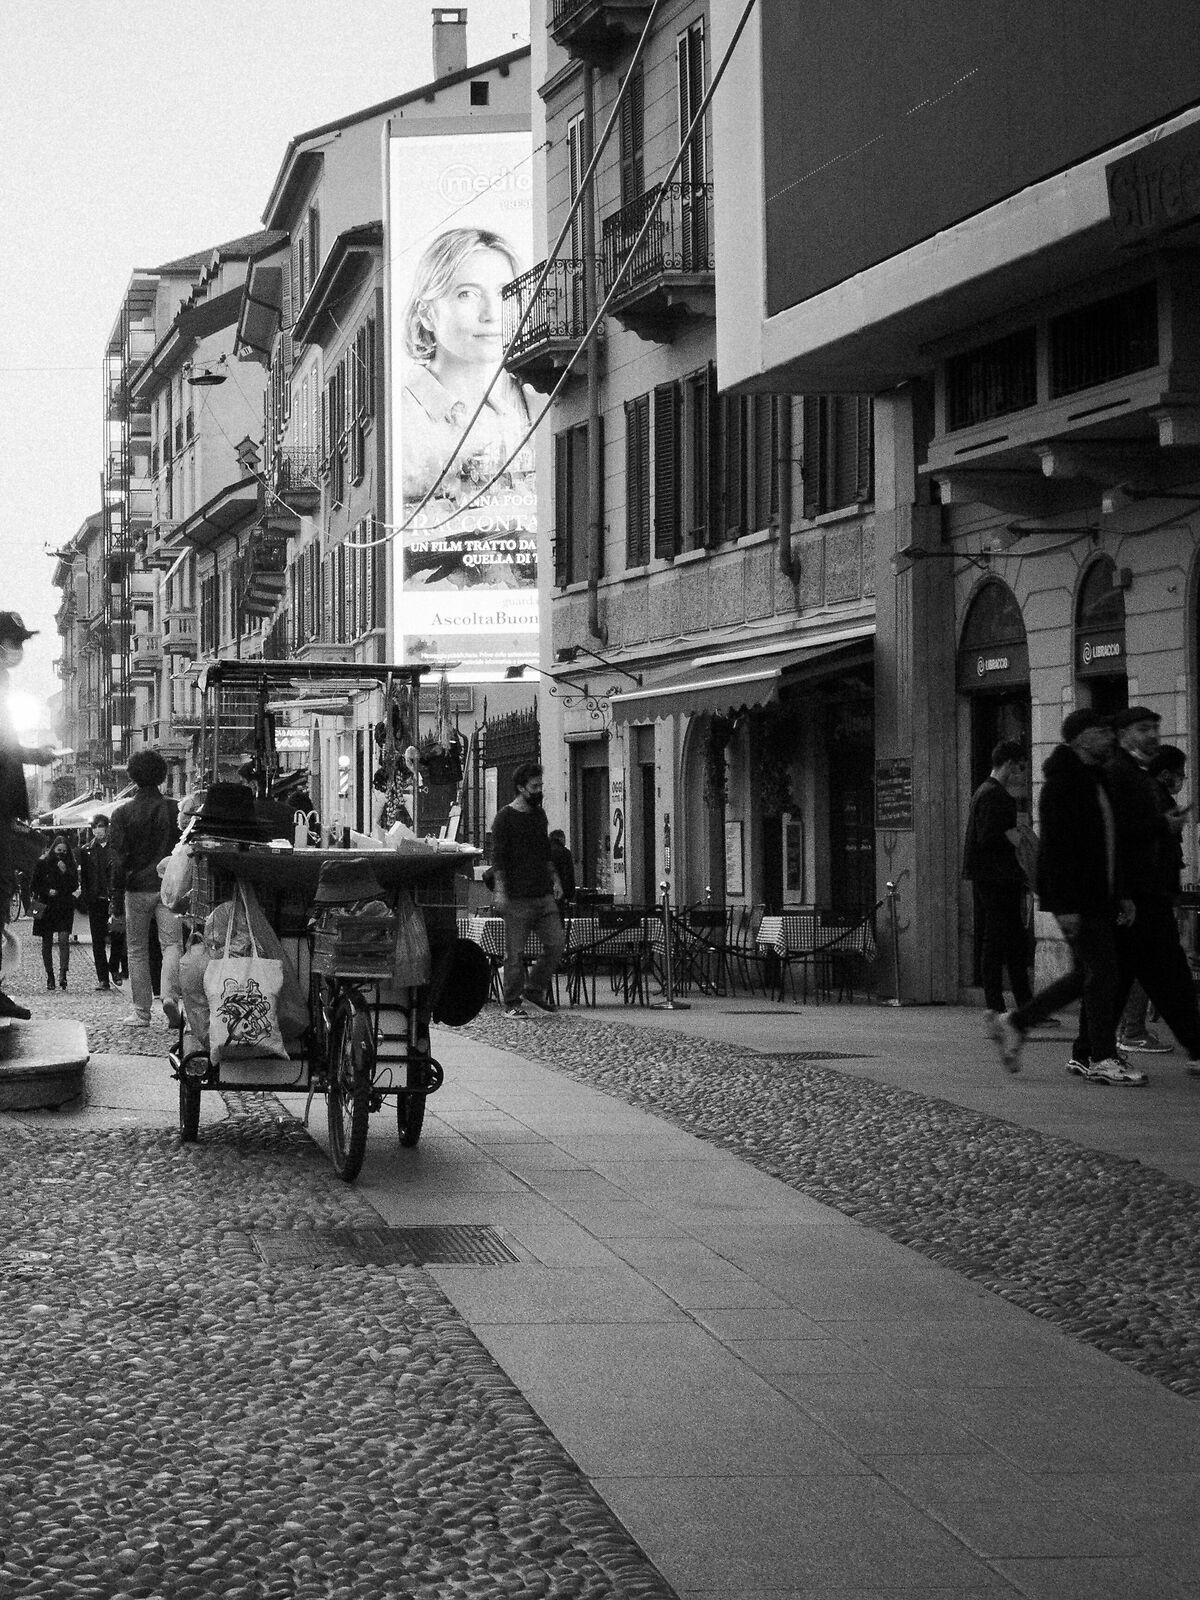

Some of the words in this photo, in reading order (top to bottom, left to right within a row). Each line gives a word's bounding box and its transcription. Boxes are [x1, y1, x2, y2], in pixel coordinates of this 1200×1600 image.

[410, 542, 429, 553] UN
[431, 541, 463, 552] FILM
[464, 540, 517, 552] TRATTO
[462, 554, 513, 567] QUELLA
[1092, 643, 1120, 658] LIBRACCIO
[985, 657, 1008, 671] LIBRACCIO
[613, 807, 624, 859] 2
